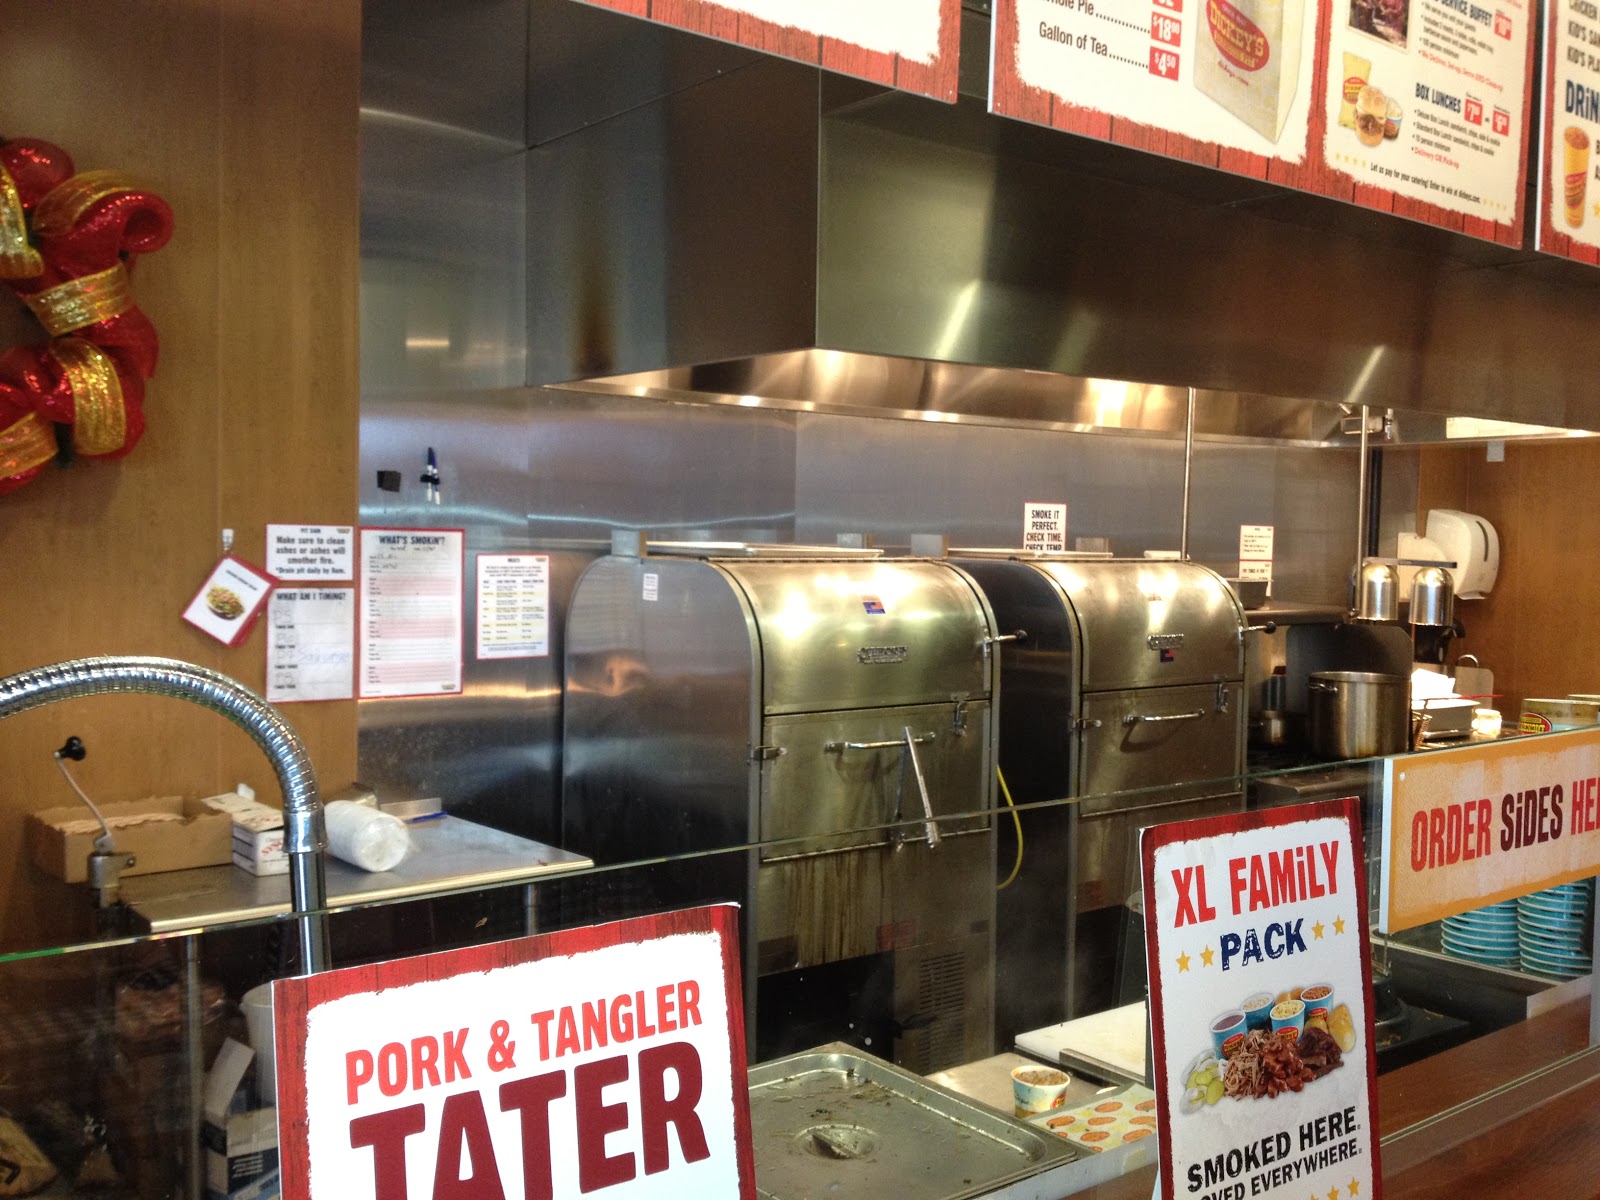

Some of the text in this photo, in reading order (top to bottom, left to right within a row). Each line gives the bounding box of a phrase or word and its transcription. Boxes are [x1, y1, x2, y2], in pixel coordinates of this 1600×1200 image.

[1039, 21, 1073, 46] Gallon
[1076, 34, 1087, 50] of
[1090, 36, 1108, 57] Tea
[1415, 82, 1429, 101] BOX
[1432, 89, 1461, 114] LUNCHES
[1031, 509, 1060, 520] SMOKE IT
[1031, 521, 1059, 531] PERFECT.
[276, 536, 295, 544] Make
[298, 537, 314, 545] sure
[327, 537, 345, 545] clean
[378, 535, 408, 545] WHAT'S
[1026, 532, 1063, 542] CHECK TIME.
[276, 546, 297, 554] ashes
[309, 547, 330, 555] ashes
[333, 547, 346, 555] will
[287, 556, 317, 564] smother
[307, 567, 321, 575] daily
[276, 592, 297, 600] WHAT
[300, 592, 310, 600] AM
[1411, 798, 1492, 873] ORDER
[1570, 777, 1600, 836] HE
[1171, 864, 1216, 929] XL
[1220, 917, 1308, 972] PACK
[345, 979, 703, 1106] PORK & TANGLER
[349, 1041, 712, 1200] TATER
[1187, 1105, 1362, 1193] SMOKED HERE.
[1250, 1137, 1363, 1197] EVERYWHERE.
